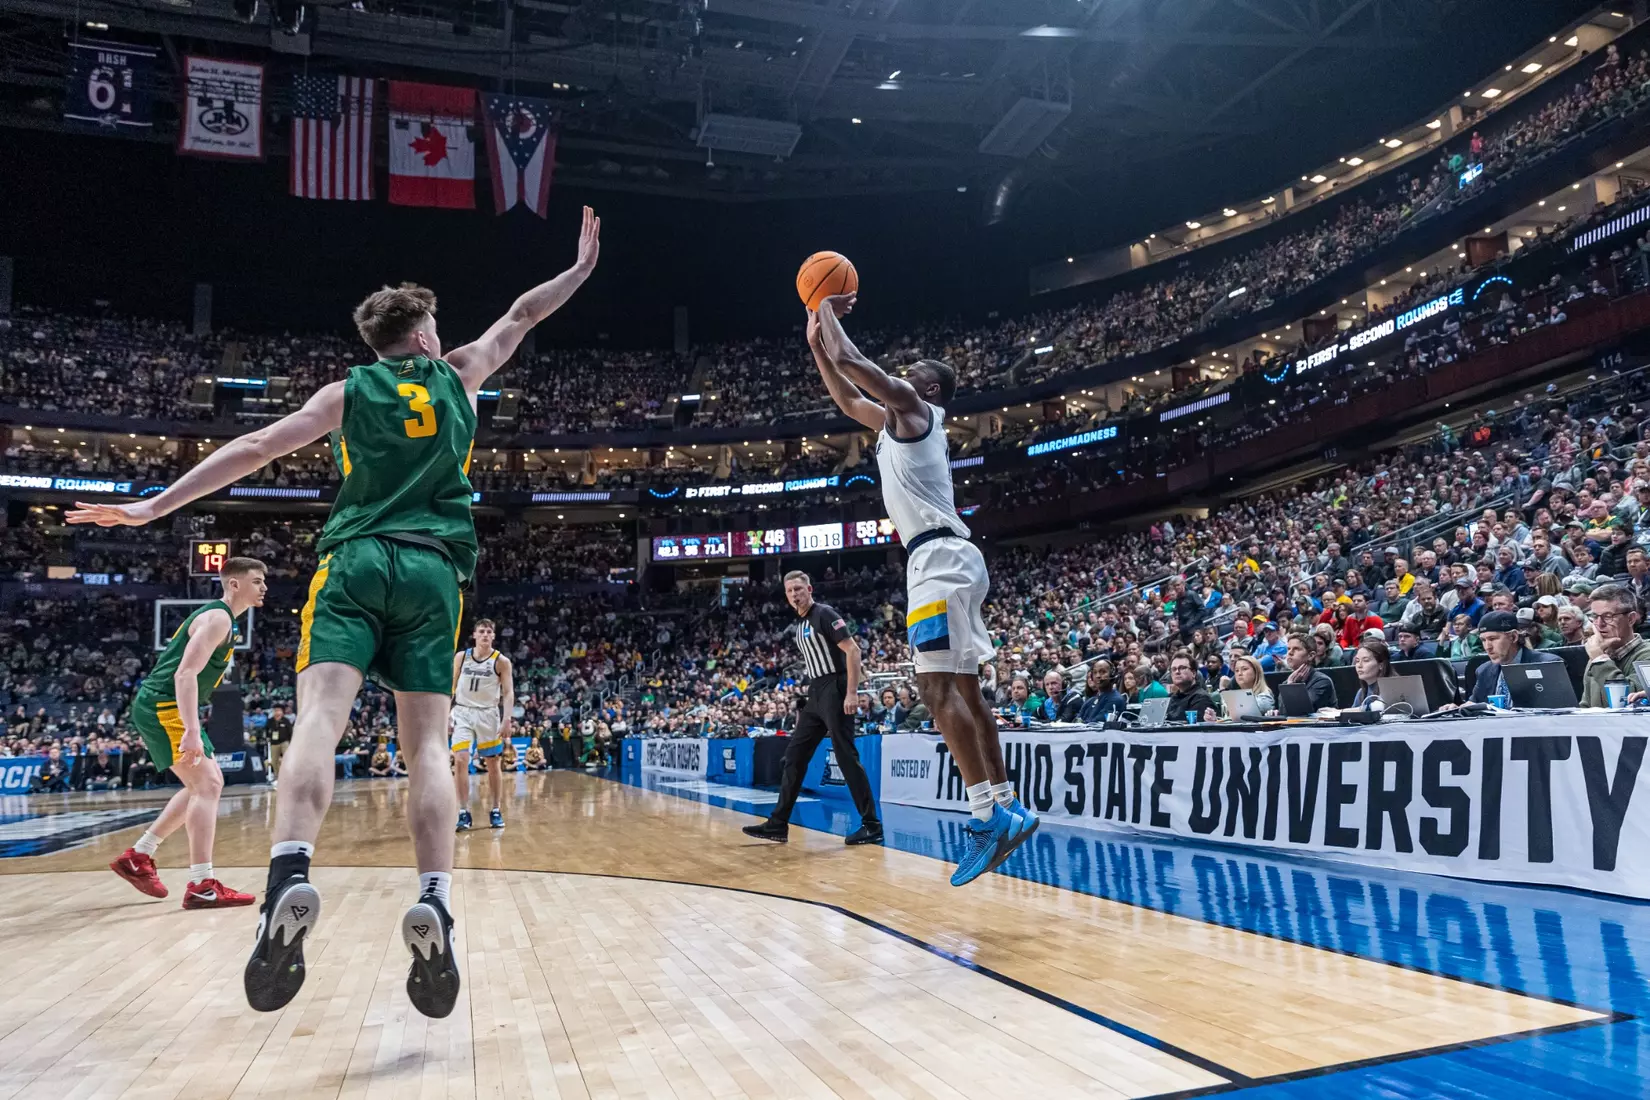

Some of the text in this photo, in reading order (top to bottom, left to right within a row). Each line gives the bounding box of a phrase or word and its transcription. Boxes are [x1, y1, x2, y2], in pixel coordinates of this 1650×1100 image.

[98, 52, 127, 65] NASH
[1308, 344, 1338, 369] FIRST
[1350, 319, 1394, 350] SECOND
[1397, 296, 1448, 330] ROUNDS
[1601, 352, 1622, 369] 114
[397, 383, 437, 438] 3
[1028, 427, 1117, 456] #MARCHMADNESS
[0, 475, 114, 492] ECOND ROUNDS
[698, 486, 731, 497] FIRST
[742, 482, 784, 494] SECOND
[785, 478, 827, 491] ROUNDS
[764, 530, 785, 546] 46
[856, 521, 877, 538] 58
[803, 533, 840, 549] 10:18
[205, 555, 223, 571] 19
[469, 678, 480, 692] 11
[891, 759, 930, 779] HOSTED BY
[1064, 742, 1180, 829] STATE
[1188, 735, 1649, 872] UNIVERSITY
